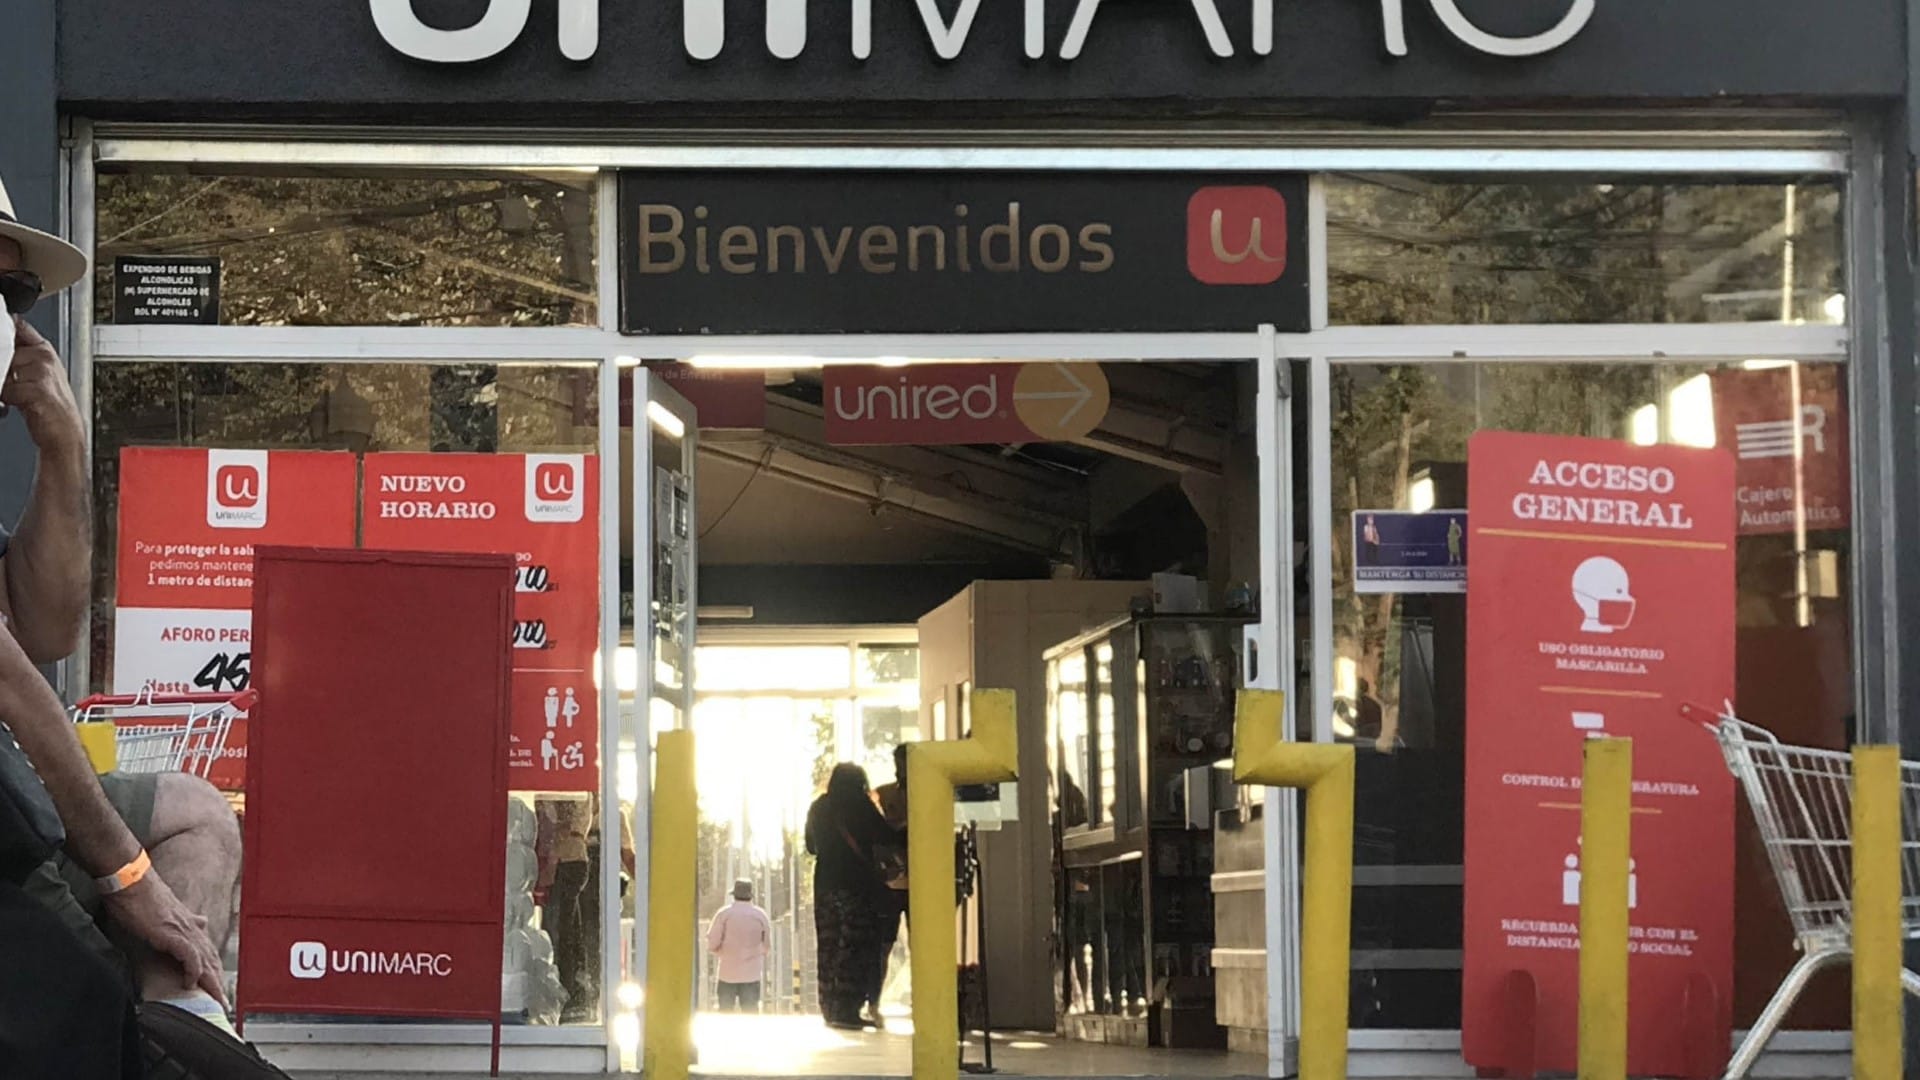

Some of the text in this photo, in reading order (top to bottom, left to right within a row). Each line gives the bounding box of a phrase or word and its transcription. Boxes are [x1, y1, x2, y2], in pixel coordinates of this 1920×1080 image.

[638, 202, 1115, 274] Bienvenidos
[167, 265, 178, 274] DE
[179, 265, 212, 275] BEBIDAS
[137, 286, 199, 296] SUPERMERCADO
[200, 287, 210, 297] DE
[146, 297, 192, 307] ALCOHOLES
[834, 374, 997, 421] unired
[379, 475, 466, 493] NUEVO
[1529, 459, 1675, 494] ACCESO
[1737, 485, 1793, 505] Cajero
[379, 501, 497, 520] HORARIO
[1512, 493, 1693, 529] GENERAL
[1739, 503, 1841, 527] Automtico
[135, 540, 162, 555] Para
[164, 543, 217, 558] proteger
[219, 543, 231, 556] la
[149, 559, 200, 572] pedimos
[147, 572, 156, 585] 1
[158, 575, 194, 586] metro
[196, 573, 211, 587] de
[161, 627, 250, 643] AFORO PER
[1538, 642, 1665, 661] USO OBLIGATORIO
[1555, 658, 1649, 674] MASCARILLA
[1502, 773, 1568, 788] CONTROL
[1632, 781, 1699, 796] ERATURA
[1501, 919, 1579, 934] RECUERDA
[1647, 927, 1676, 939] CON
[1679, 929, 1699, 941] EL
[1640, 943, 1693, 956] SOCIAL
[332, 950, 453, 976] UNIMARC
